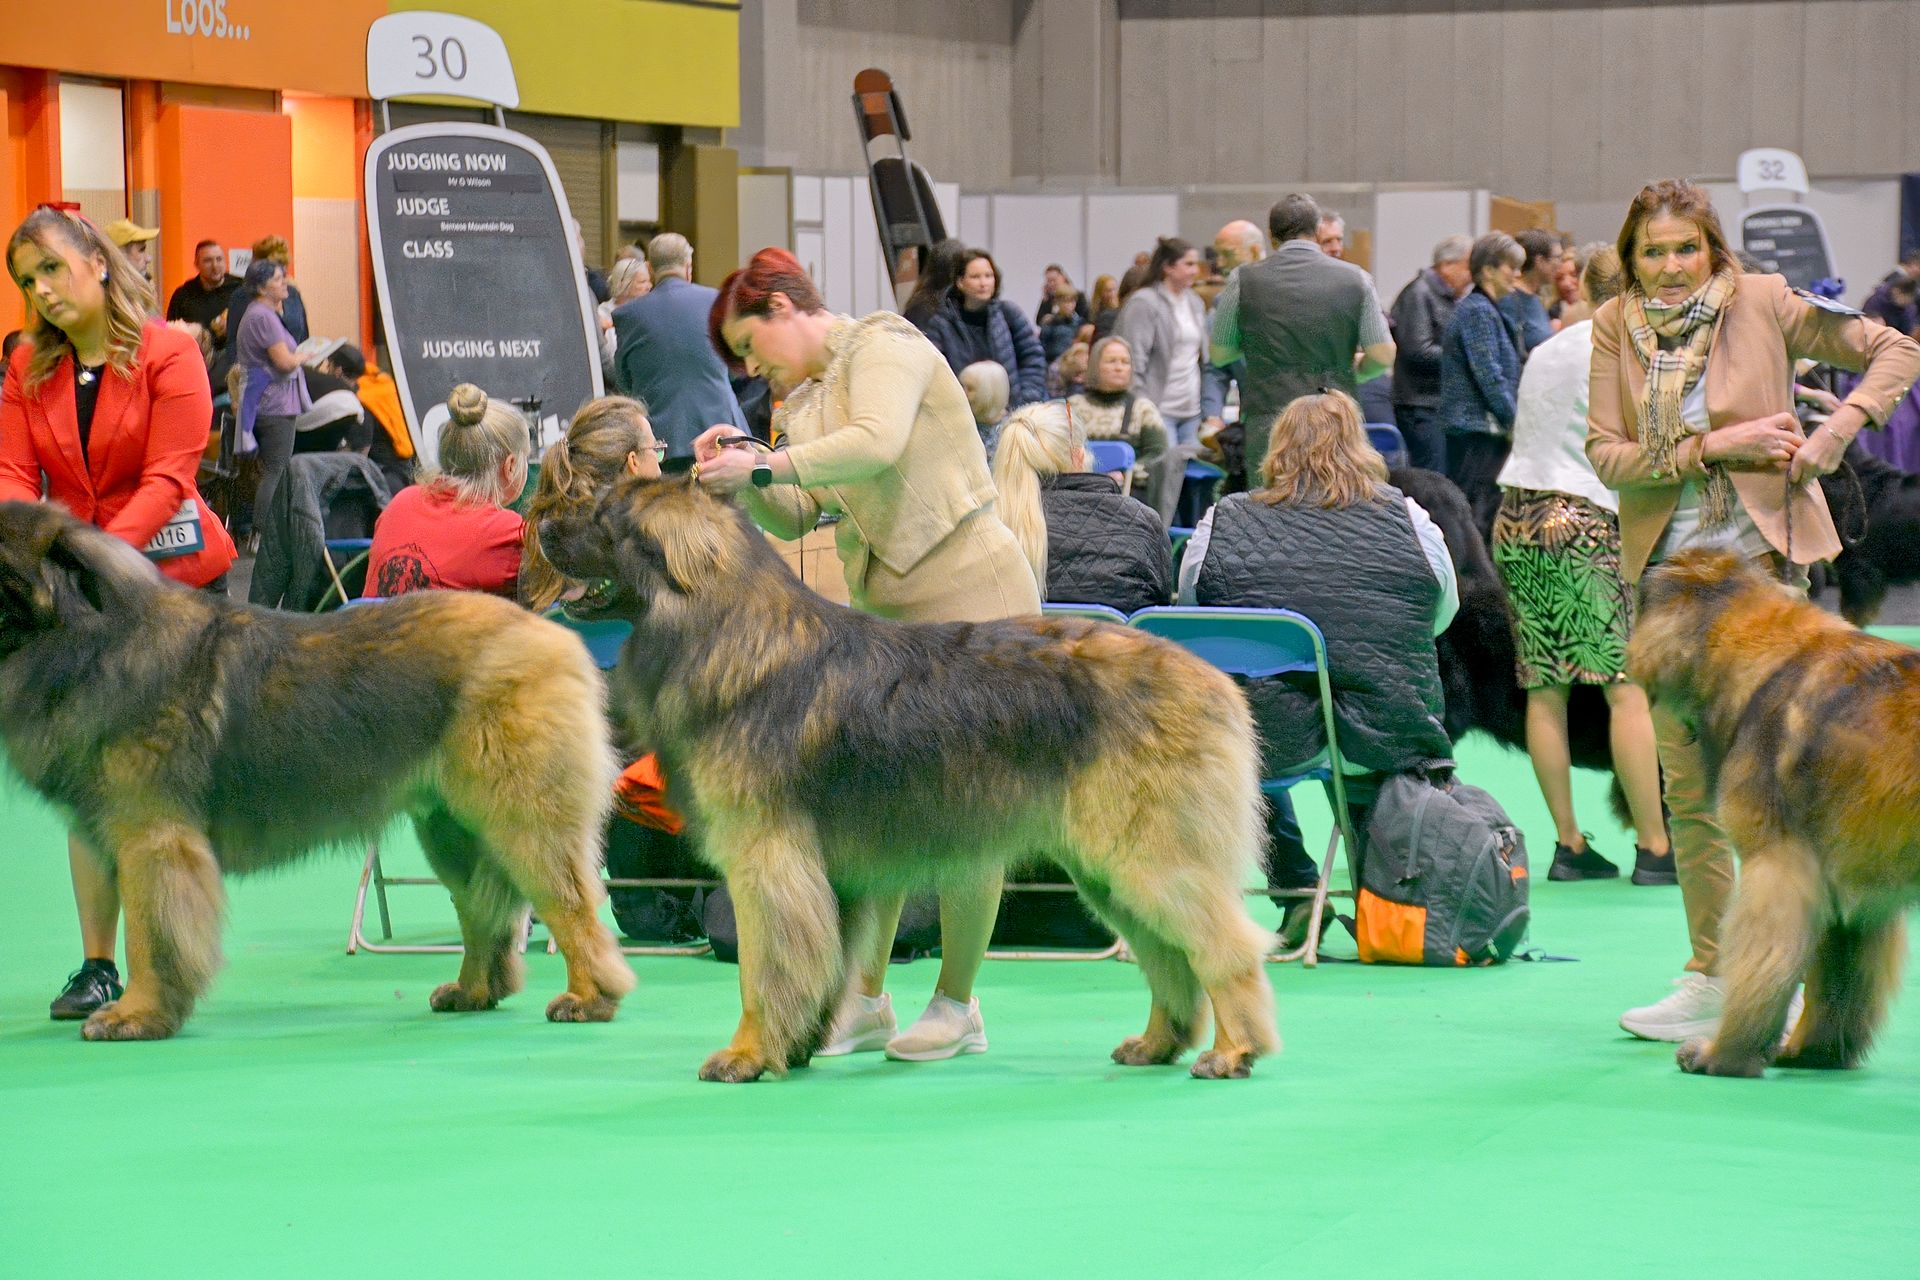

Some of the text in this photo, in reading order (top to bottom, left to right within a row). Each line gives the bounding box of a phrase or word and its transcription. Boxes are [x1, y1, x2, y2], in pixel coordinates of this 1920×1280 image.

[166, 0, 250, 40] LOOS...
[412, 35, 467, 81] 30
[388, 152, 507, 171] JUDGING NOW
[1758, 160, 1786, 181] 32
[396, 198, 450, 216] JUDGE
[467, 222, 499, 232] Mountain
[500, 221, 515, 233] Dog
[403, 240, 454, 258] CLASS
[422, 340, 541, 359] JUDGING NEXT
